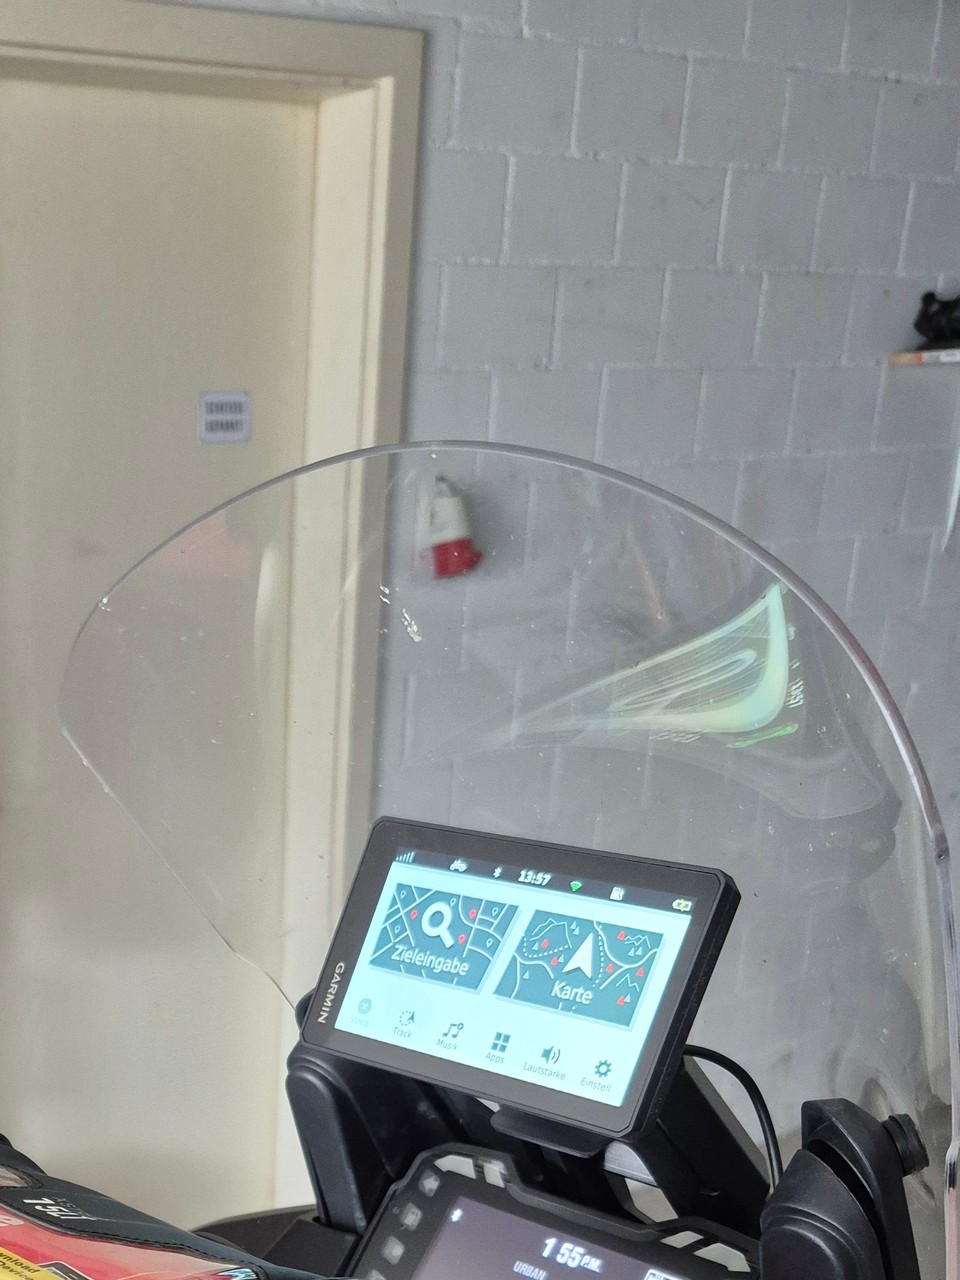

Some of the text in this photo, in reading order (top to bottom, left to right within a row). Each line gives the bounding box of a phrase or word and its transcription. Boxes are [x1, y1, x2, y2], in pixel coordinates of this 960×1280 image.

[518, 868, 552, 886] 13:57
[391, 945, 469, 976] Zieleingabe
[317, 962, 345, 1024] GARMIN
[551, 980, 592, 1004] Karte
[393, 1026, 413, 1039] Track
[436, 1039, 458, 1051] Musik
[485, 1052, 505, 1065] Apps
[523, 1062, 566, 1082] Lautstärke
